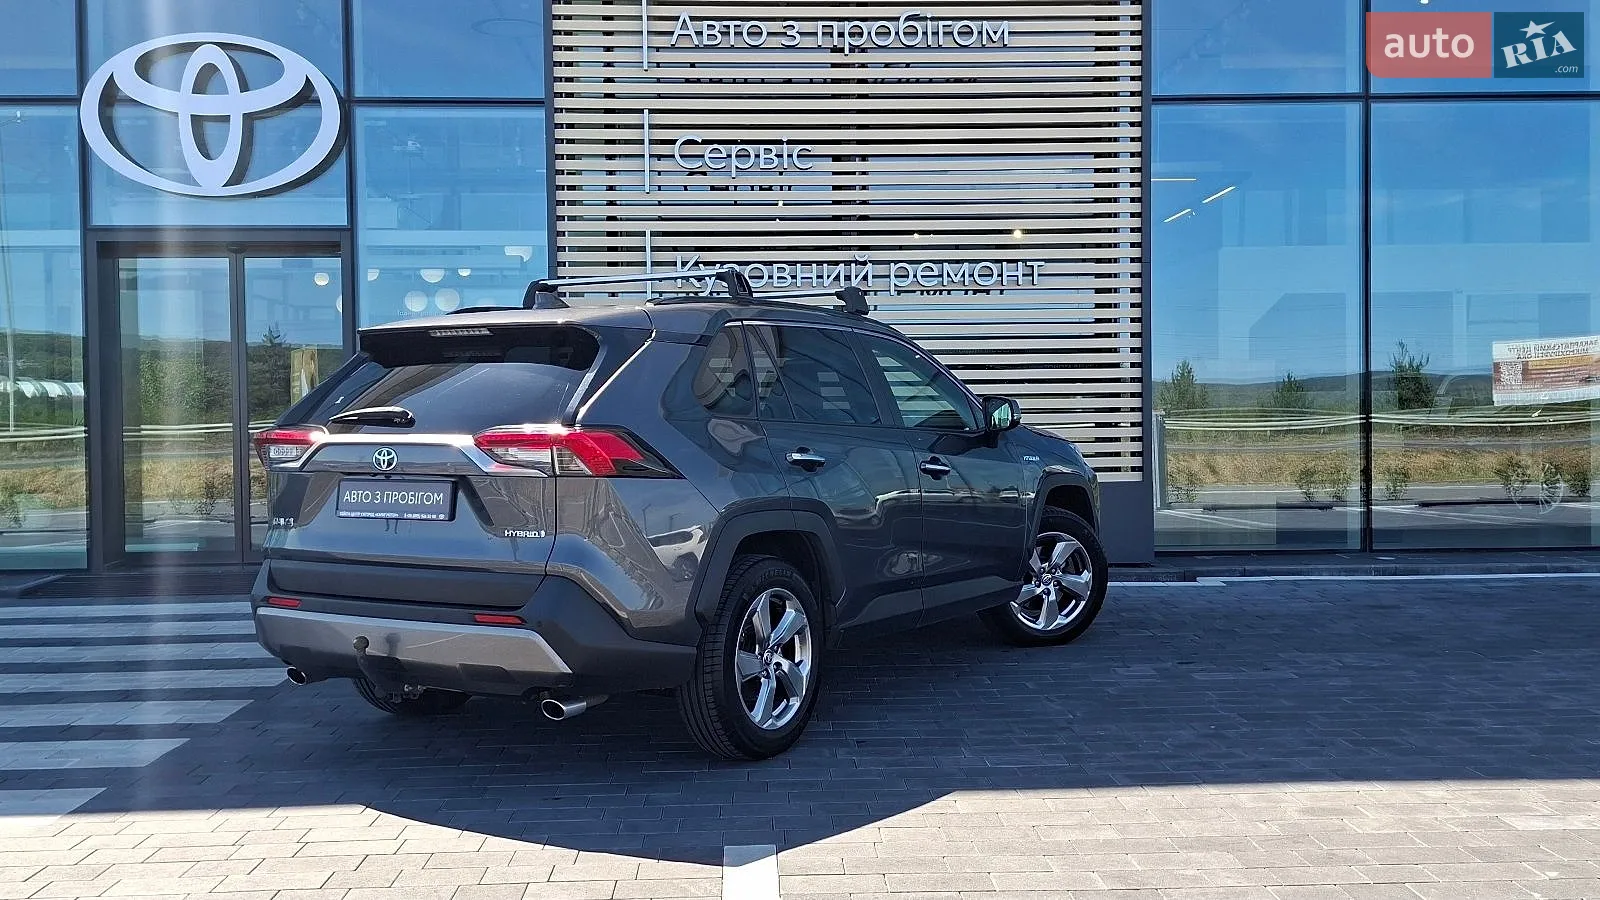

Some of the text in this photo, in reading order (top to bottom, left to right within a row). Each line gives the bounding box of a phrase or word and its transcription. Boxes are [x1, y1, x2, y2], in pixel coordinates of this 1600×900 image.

[670, 10, 1010, 56] Авто з пробігом
[673, 135, 815, 179] Сервіс
[890, 258, 1046, 296] ремонт
[343, 490, 443, 505] АВТО З ПРОБІГОМ
[504, 529, 541, 538] HYBRID
